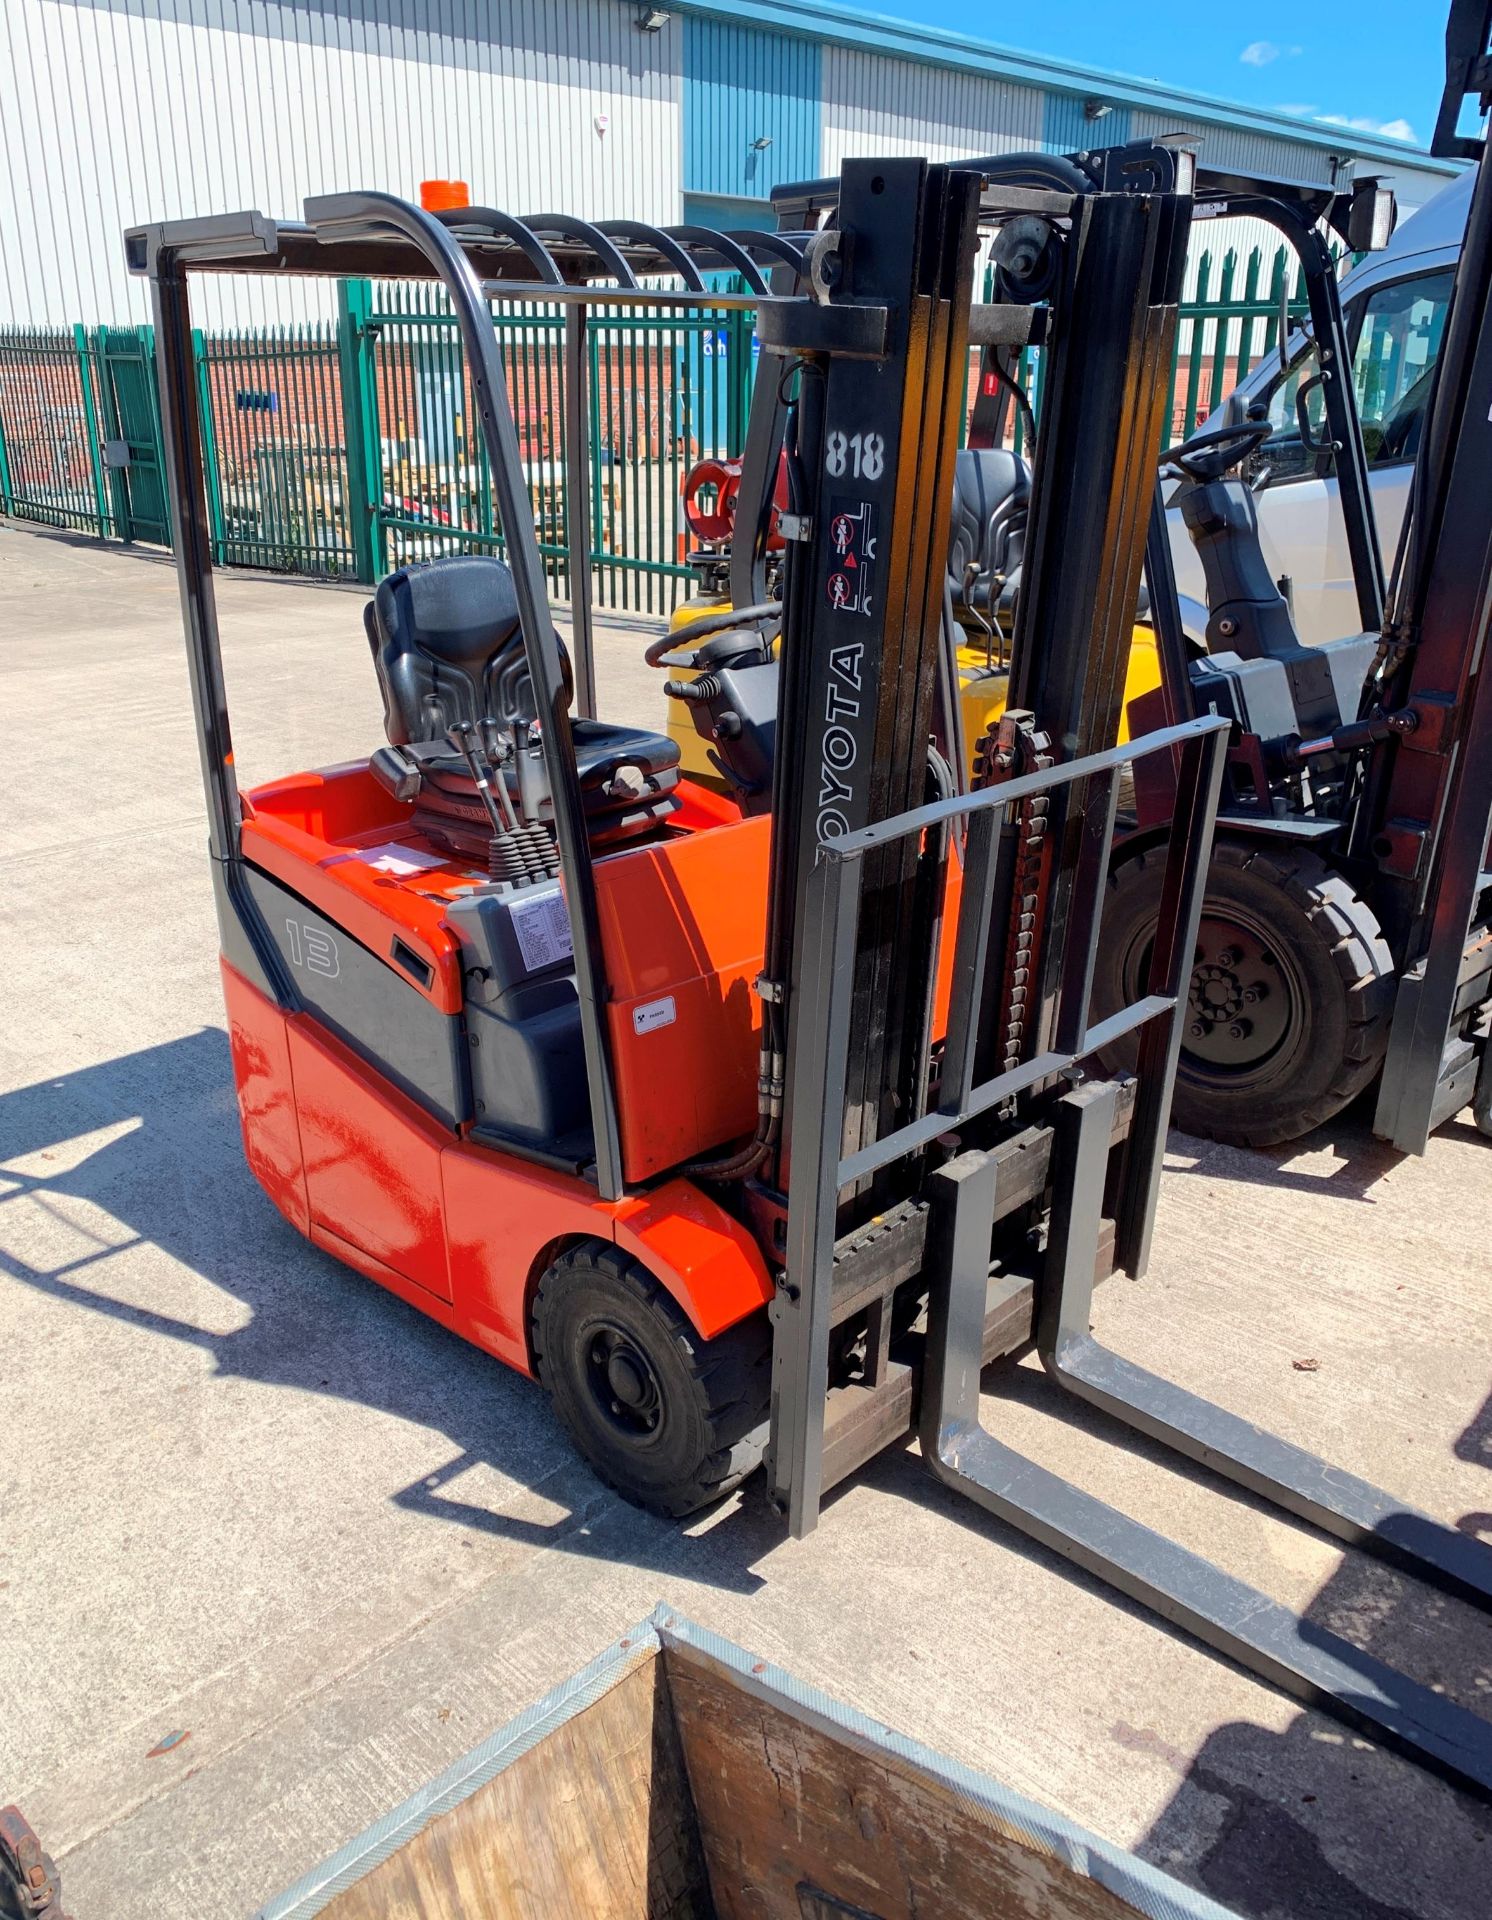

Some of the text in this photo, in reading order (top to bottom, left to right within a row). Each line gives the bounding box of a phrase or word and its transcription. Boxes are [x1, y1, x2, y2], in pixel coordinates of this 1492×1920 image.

[826, 431, 884, 480] 818
[815, 642, 864, 866] OYOTA
[286, 918, 340, 978] 13
